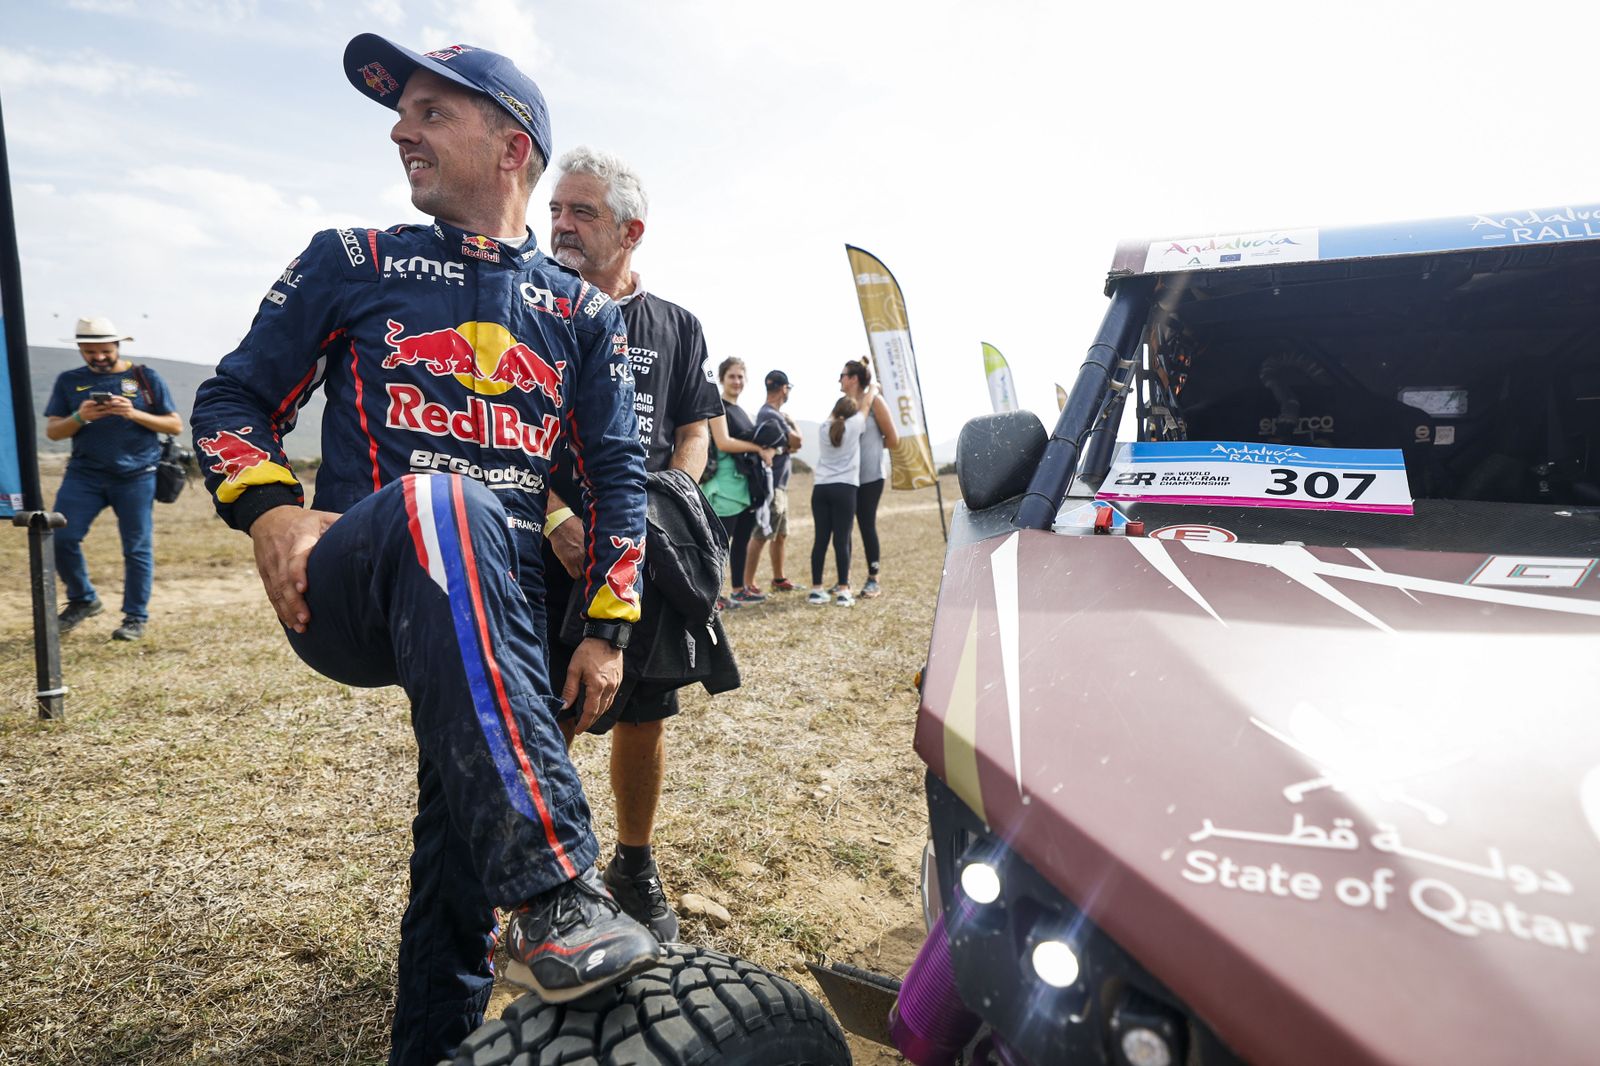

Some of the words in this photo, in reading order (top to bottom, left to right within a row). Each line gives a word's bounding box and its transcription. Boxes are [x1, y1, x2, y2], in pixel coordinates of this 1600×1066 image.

[1163, 233, 1302, 256] Andalucía
[1512, 222, 1600, 242] RALL
[461, 245, 482, 259] Red
[482, 251, 500, 264] Bull
[385, 382, 490, 449] Red
[489, 402, 561, 460] Bull
[1211, 443, 1307, 459] Andalucía
[1228, 453, 1287, 464] RALLY
[409, 449, 545, 490] BFGoodrich
[1264, 468, 1377, 501] 307
[1188, 813, 1359, 850] قطر
[1181, 849, 1323, 901] State
[1335, 868, 1396, 911] of
[1409, 877, 1597, 954] Qatar
